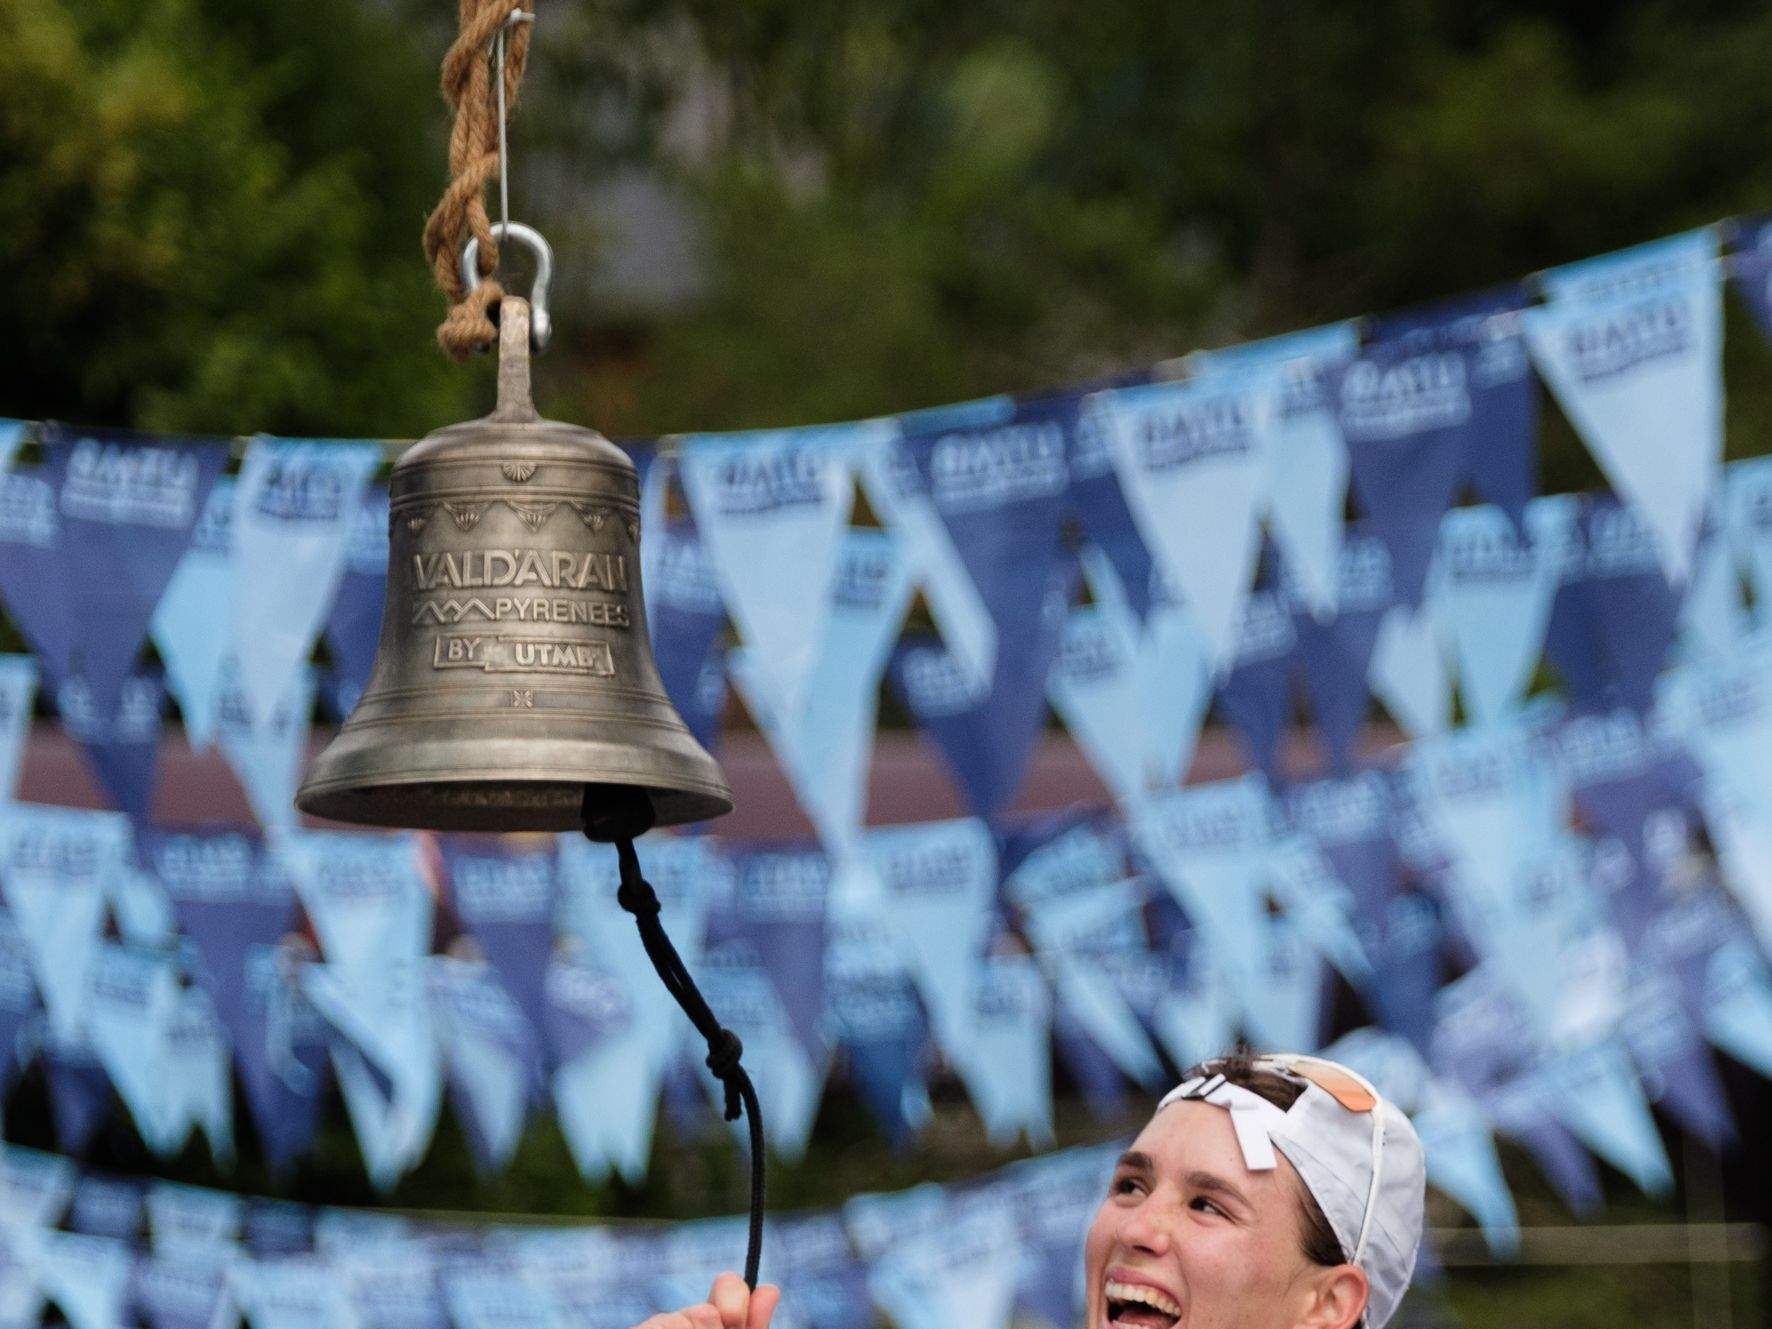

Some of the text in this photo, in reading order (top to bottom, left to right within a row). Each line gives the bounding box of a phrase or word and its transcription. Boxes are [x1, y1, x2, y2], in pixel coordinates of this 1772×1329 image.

[495, 598, 630, 628] PYRENEES
[448, 638, 594, 669] BY UTMB
